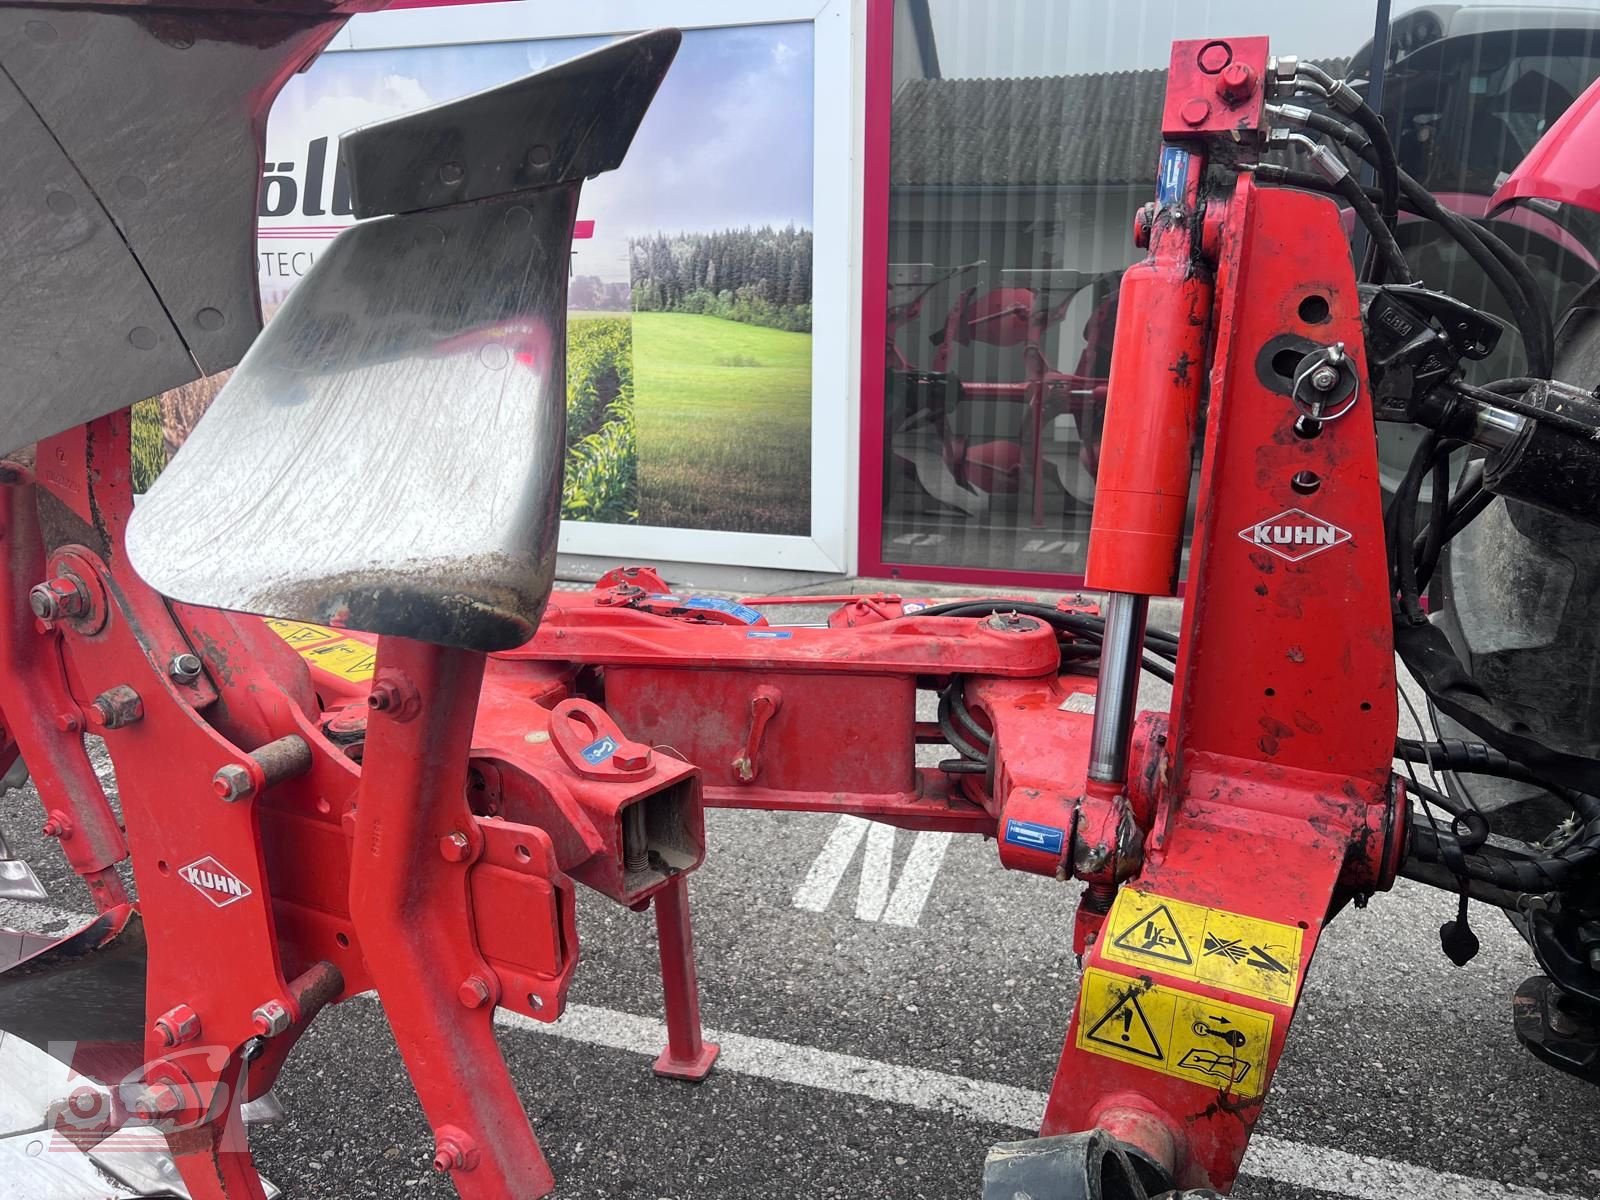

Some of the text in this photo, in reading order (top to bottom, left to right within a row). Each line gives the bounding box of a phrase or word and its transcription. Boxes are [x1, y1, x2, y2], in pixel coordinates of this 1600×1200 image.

[257, 251, 314, 277] TEC
[1253, 525, 1335, 545] KUHN
[187, 867, 242, 896] KUHN
